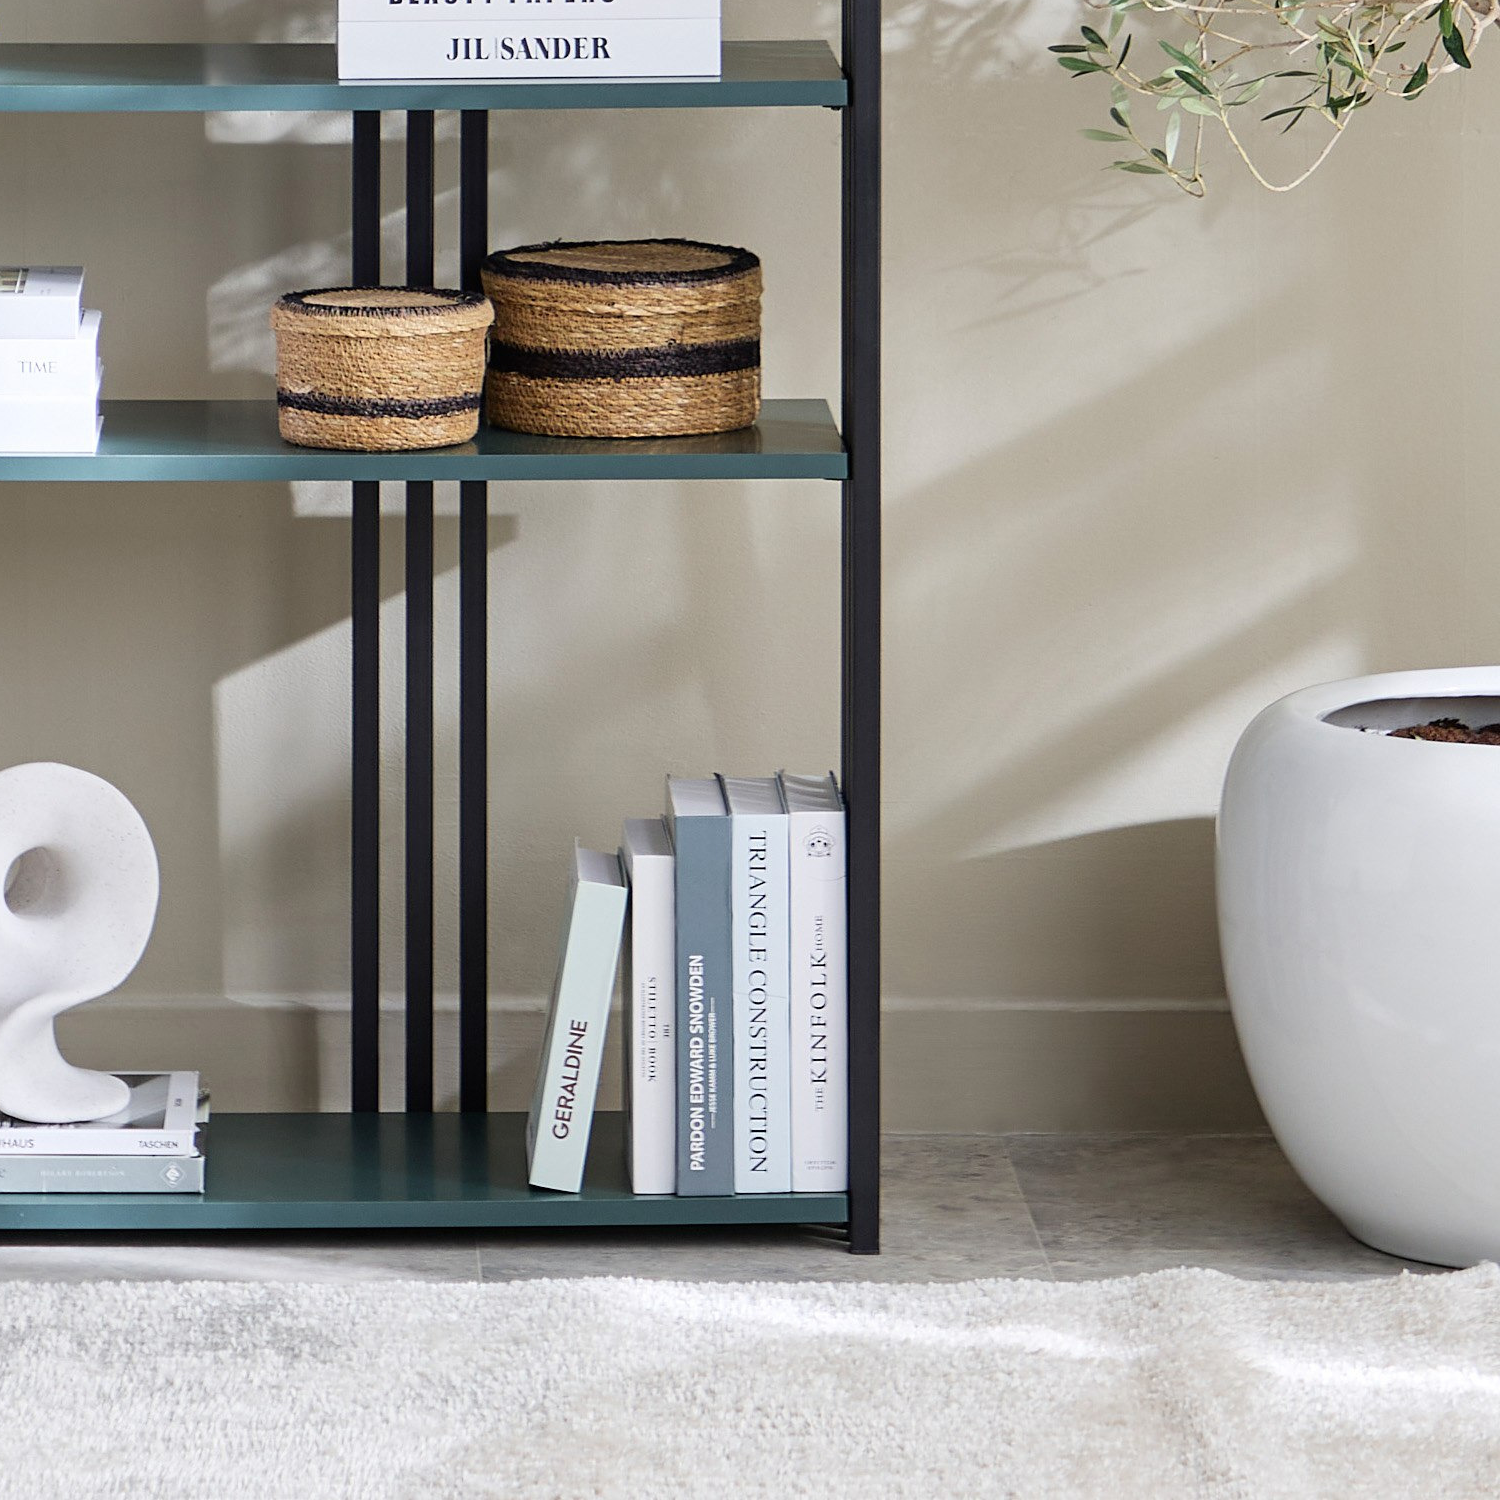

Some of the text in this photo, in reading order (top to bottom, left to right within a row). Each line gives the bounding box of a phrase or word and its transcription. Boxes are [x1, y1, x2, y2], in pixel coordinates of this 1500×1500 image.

[446, 36, 611, 61] JIL SANDER
[18, 360, 58, 374] TIME
[749, 829, 768, 1173] TRIANGLE CONSTRUCTION
[810, 915, 827, 1111] THE KINFOLK HOME
[648, 977, 656, 1082] STILETTO BOOK
[707, 1012, 717, 1043] BROWER
[688, 954, 705, 1171] PARDON EDWARD SNOWDEN
[707, 1044, 717, 1062] LUKE
[552, 1018, 588, 1140] GERALDINE
[707, 1069, 717, 1093] KAMM
[707, 1093, 717, 1114] JESSE
[137, 1140, 179, 1149] TASCHEN
